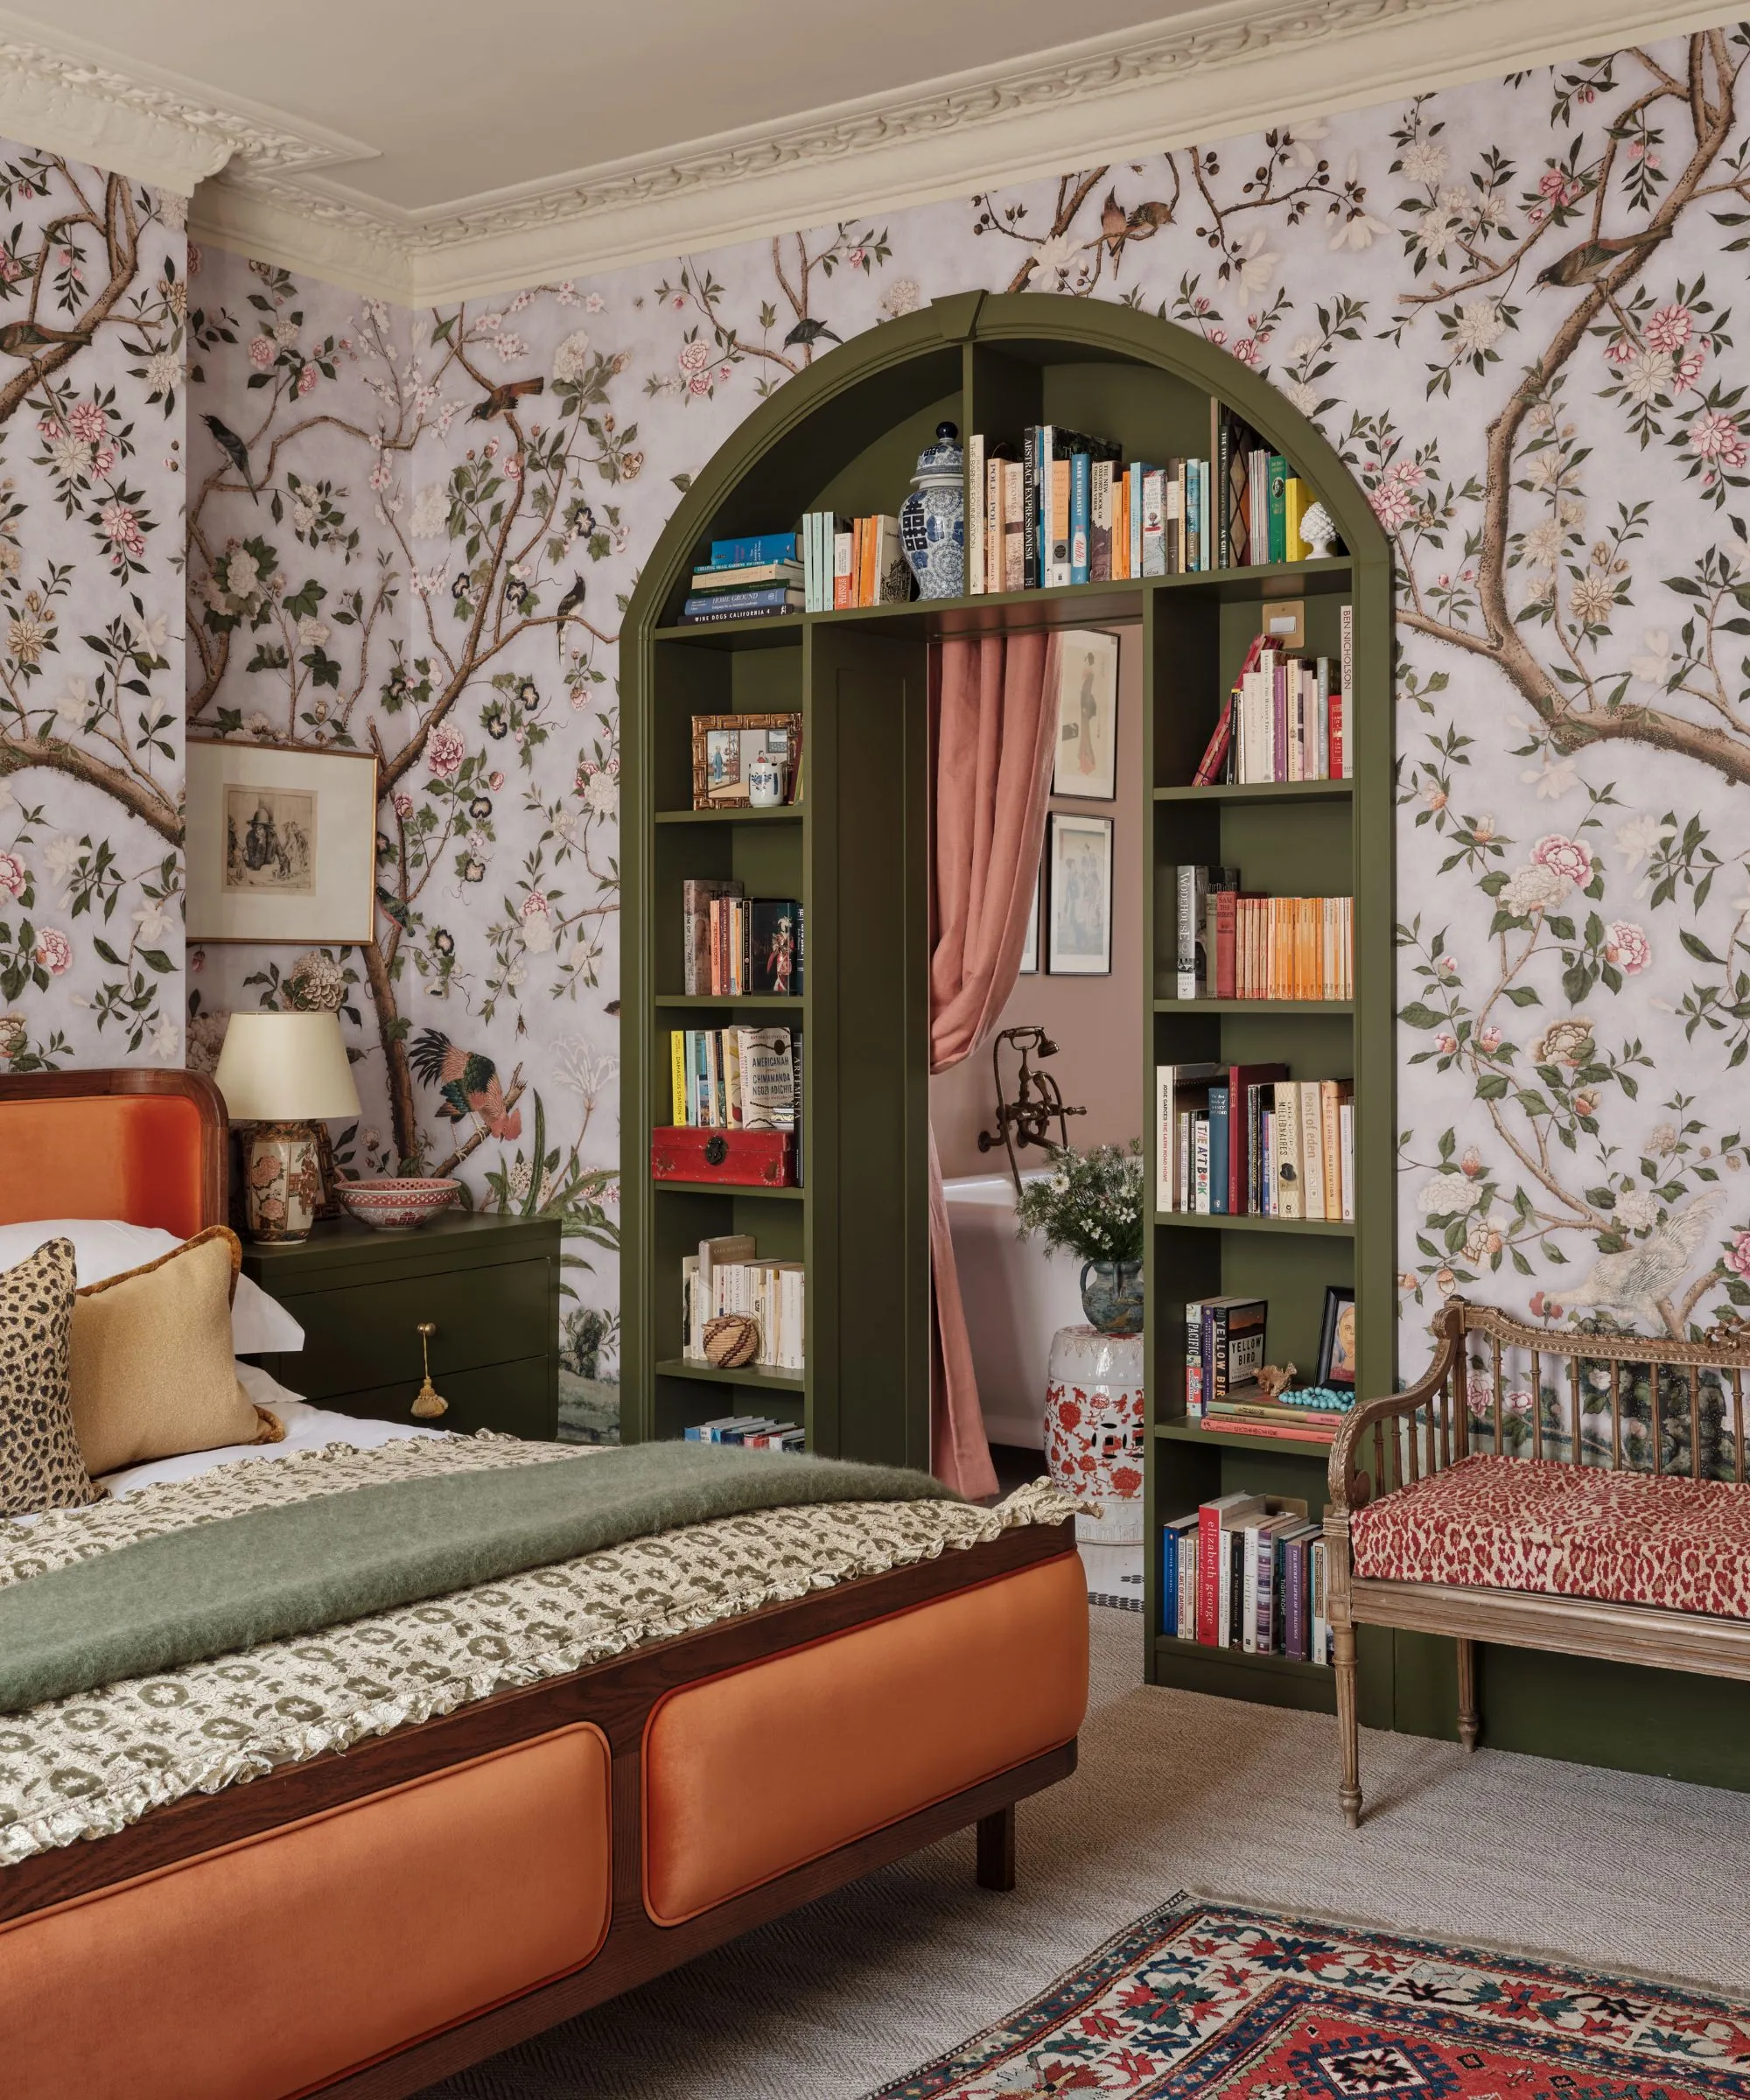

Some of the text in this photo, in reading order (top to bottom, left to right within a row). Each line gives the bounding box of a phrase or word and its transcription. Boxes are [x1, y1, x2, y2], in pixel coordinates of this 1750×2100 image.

[1025, 438, 1033, 560] ABSTRACT EXPRESSIONISM
[1221, 529, 1227, 539] AA
[732, 592, 759, 602] GROUND
[729, 610, 765, 619] CALIFORNIA
[1180, 872, 1190, 940] WODEHOUSE
[752, 1057, 789, 1068] AMERICANAH
[752, 1073, 791, 1084] CHIMAMANDA
[752, 1084, 793, 1096] NGOZI ADICHIE
[1278, 1101, 1288, 1156] MILLIONAIRES
[1305, 1091, 1318, 1158] feast of eden
[1197, 1124, 1208, 1144] THE
[1188, 1323, 1200, 1354] PACIFIC
[1231, 1337, 1262, 1354] YELLOW
[1216, 1321, 1226, 1397] YELLOW BIR
[1238, 1352, 1255, 1366] BIRD
[1205, 1521, 1217, 1625] elizabeth george
